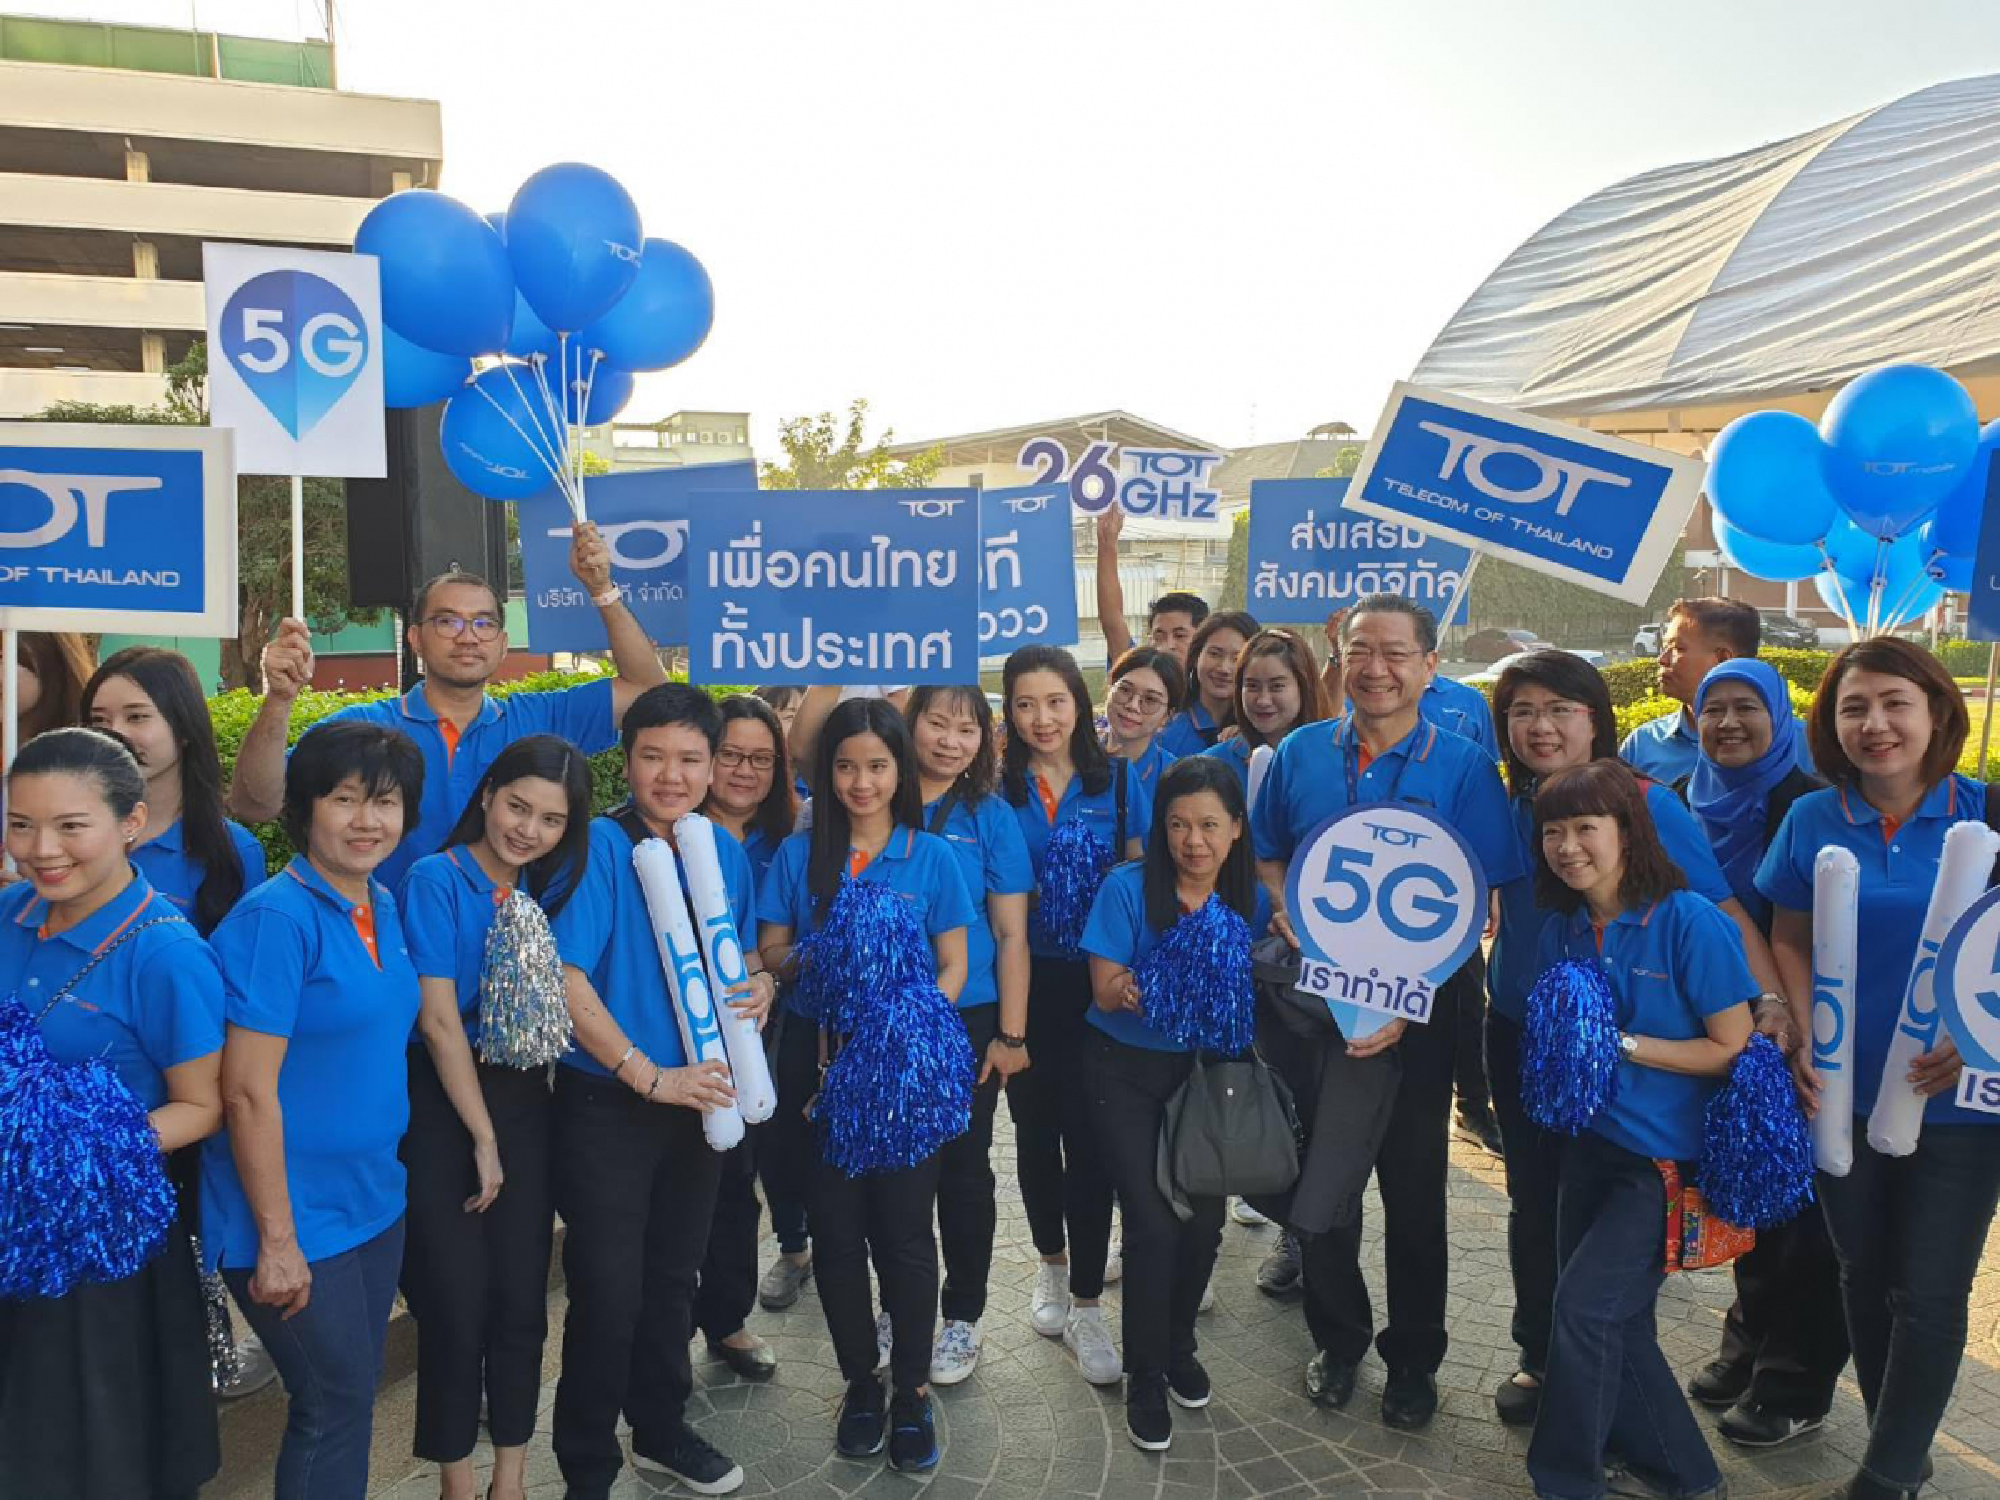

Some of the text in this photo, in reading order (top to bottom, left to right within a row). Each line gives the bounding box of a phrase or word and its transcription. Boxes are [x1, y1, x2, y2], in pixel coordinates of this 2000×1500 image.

[237, 307, 363, 378] 5G
[1021, 441, 1117, 513] 26
[1122, 450, 1220, 477] TOT
[1417, 421, 1632, 516] TOT
[897, 499, 965, 518] TOT
[1002, 495, 1056, 513] TOT
[1121, 477, 1218, 518] GHz
[1384, 477, 1614, 560] TELECOM OF THAILAND
[36, 566, 181, 588] THAILAND
[708, 520, 957, 588] เพื่อคนไทย
[712, 601, 953, 668] ทั้งประเทศ
[1362, 822, 1432, 848] TOT
[1312, 844, 1459, 943] 5G
[1301, 962, 1431, 1018] เราทำได้
